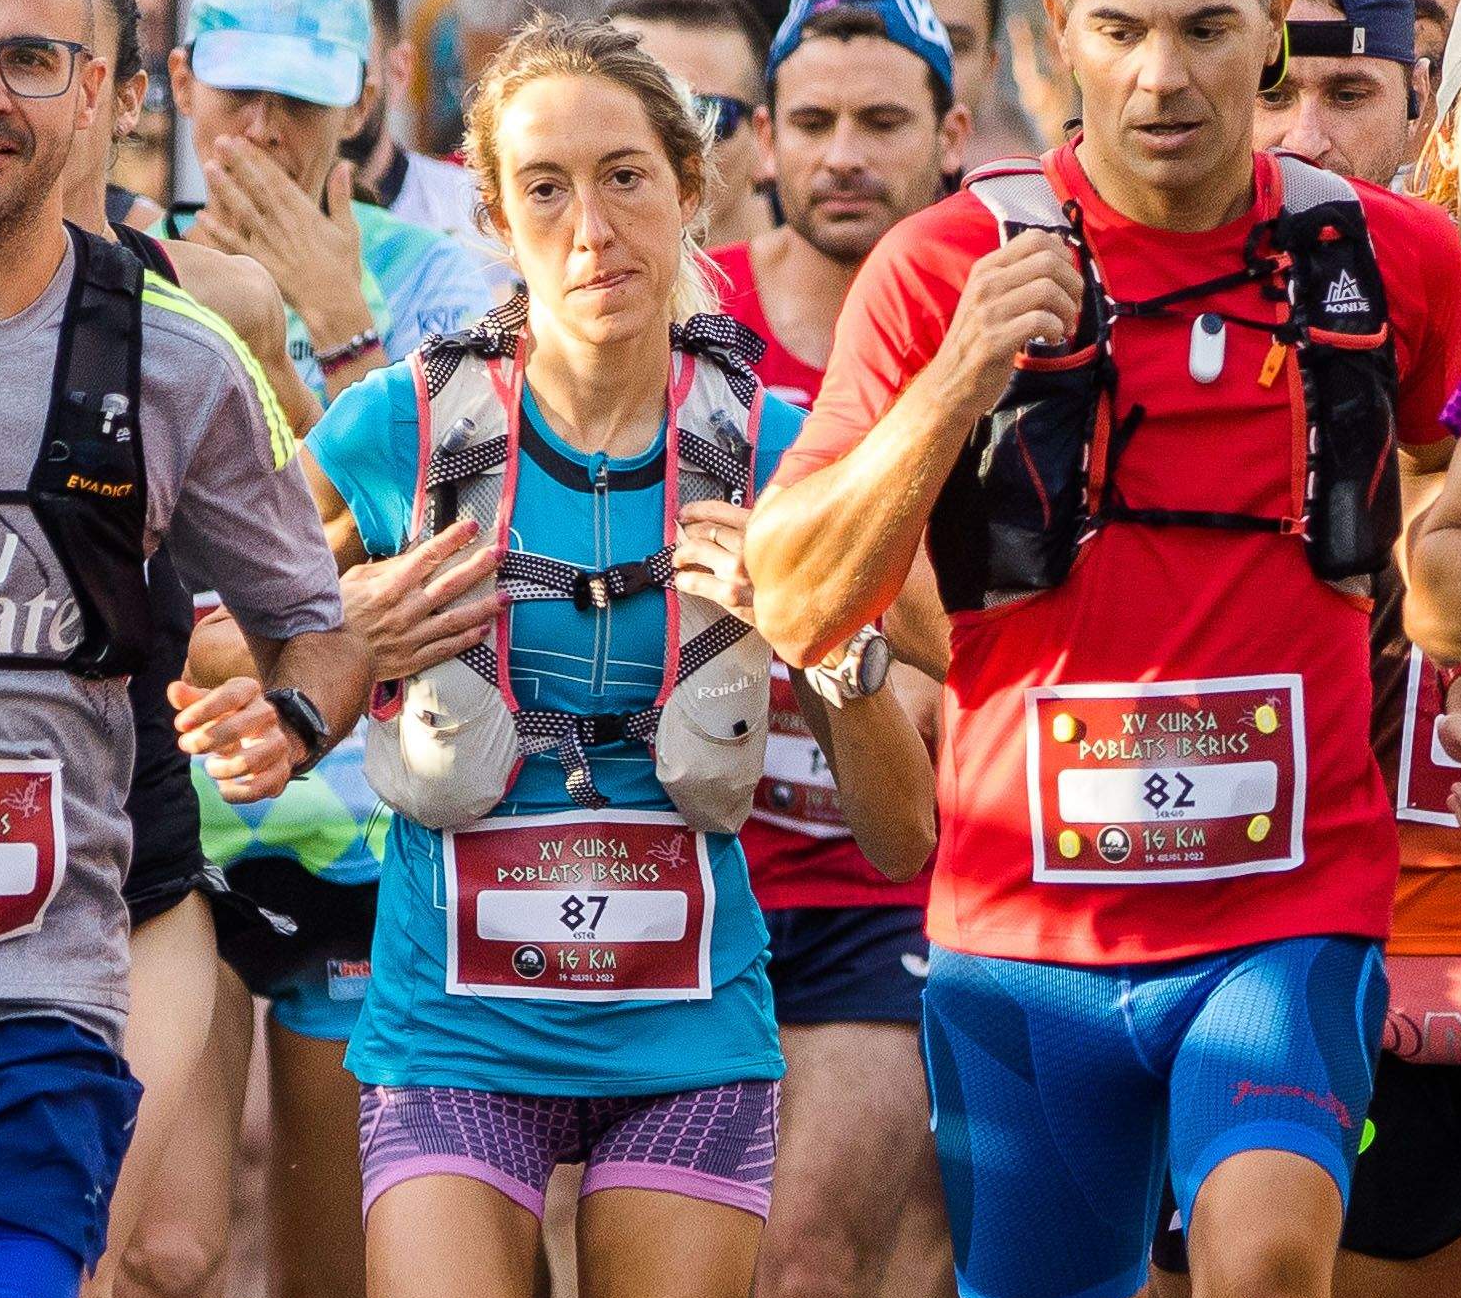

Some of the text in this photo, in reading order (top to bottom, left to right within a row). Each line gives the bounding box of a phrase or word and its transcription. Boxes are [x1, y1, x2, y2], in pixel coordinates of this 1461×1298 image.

[1325, 302, 1371, 314] AONIJE
[66, 474, 133, 498] EVADICT
[1121, 710, 1218, 734] XV CURSA
[1078, 738, 1166, 760] POBLATS
[1143, 771, 1195, 810] 82
[539, 838, 629, 861] XV CURSA
[1142, 826, 1207, 851] 16 KM
[496, 865, 582, 883] POBLATS
[559, 894, 609, 932] 87
[557, 949, 617, 970] 16 KM
